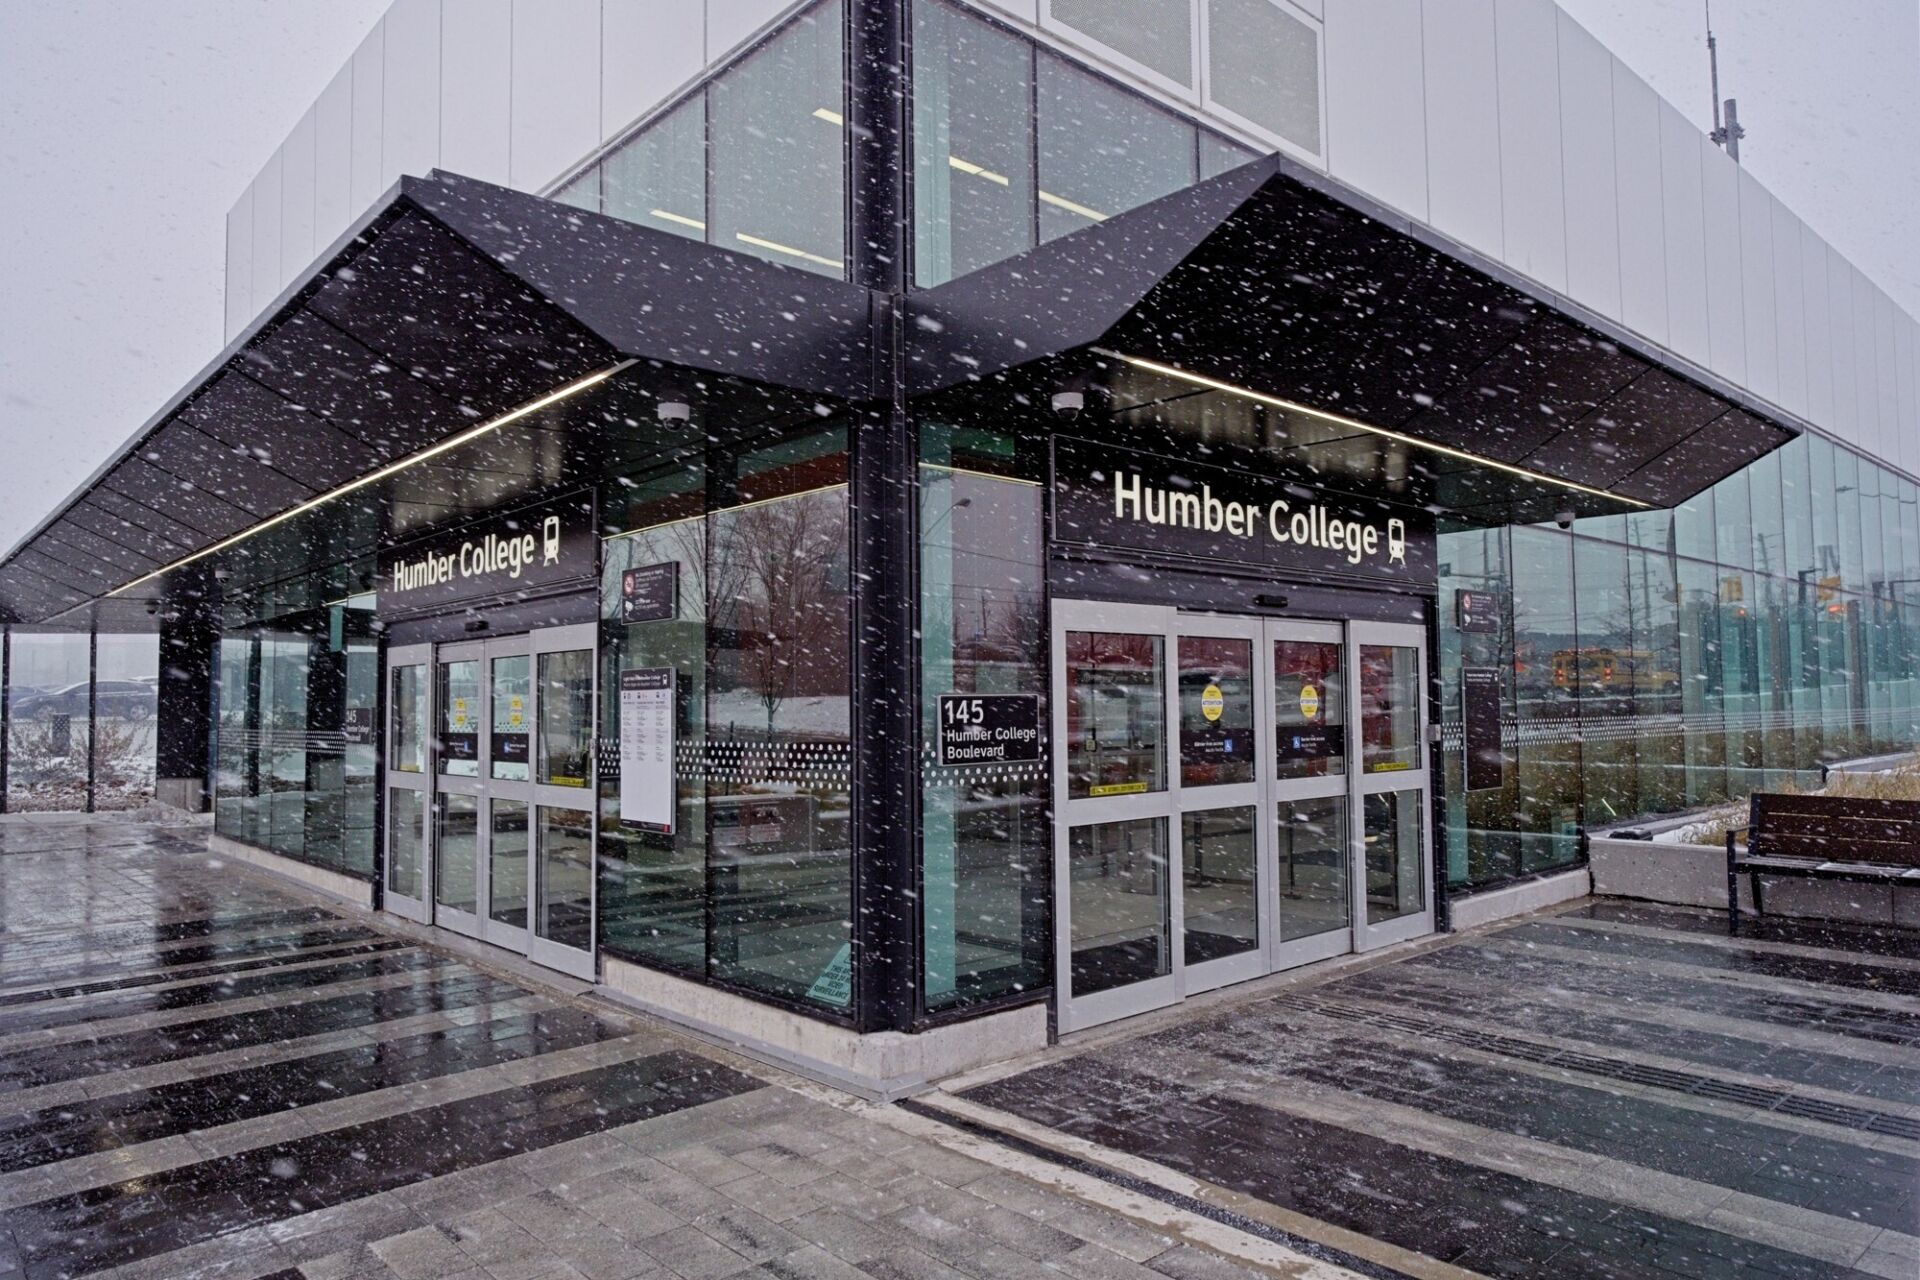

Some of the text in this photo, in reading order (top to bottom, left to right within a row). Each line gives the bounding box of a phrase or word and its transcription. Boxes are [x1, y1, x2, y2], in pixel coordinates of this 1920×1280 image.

[1115, 471, 1378, 564] Humber College
[394, 534, 535, 592] Humber College
[945, 700, 984, 724] 145
[947, 726, 1037, 742] Humber College
[947, 743, 1005, 759] Boulevard
